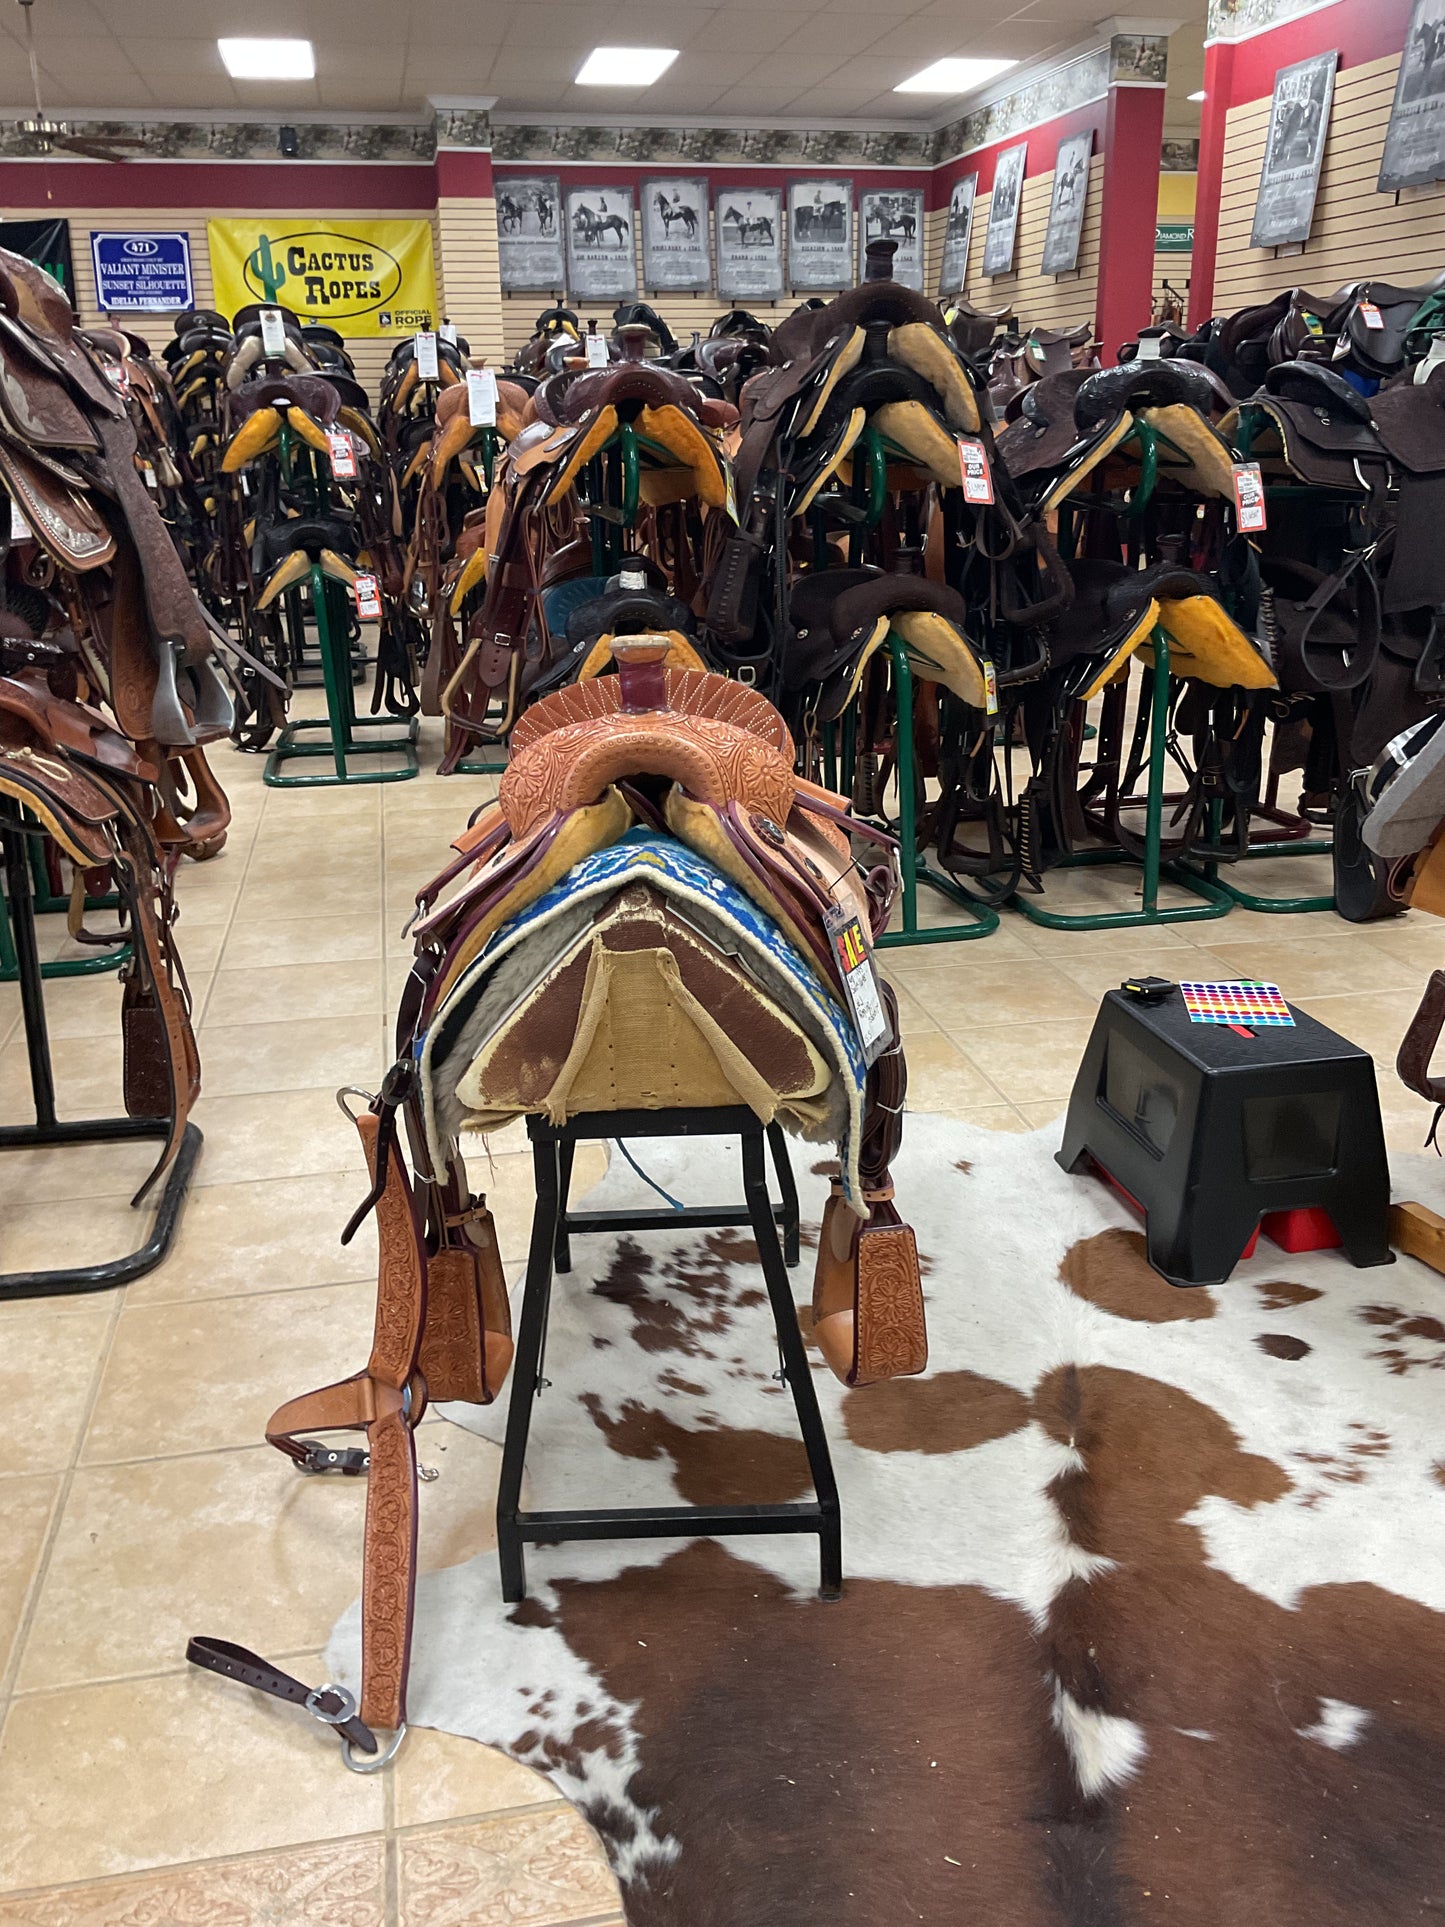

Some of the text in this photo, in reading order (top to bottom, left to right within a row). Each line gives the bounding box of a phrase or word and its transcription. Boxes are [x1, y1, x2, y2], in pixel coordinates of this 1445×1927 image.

[131, 242, 149, 252] 471
[287, 246, 374, 275] CACTUS
[100, 263, 184, 275] VALIANT MINISTER
[103, 280, 186, 290] SUNSET SILHOUETTE
[304, 276, 381, 304] ROPES
[394, 315, 432, 325] ROPE
[836, 924, 868, 972] SALE
